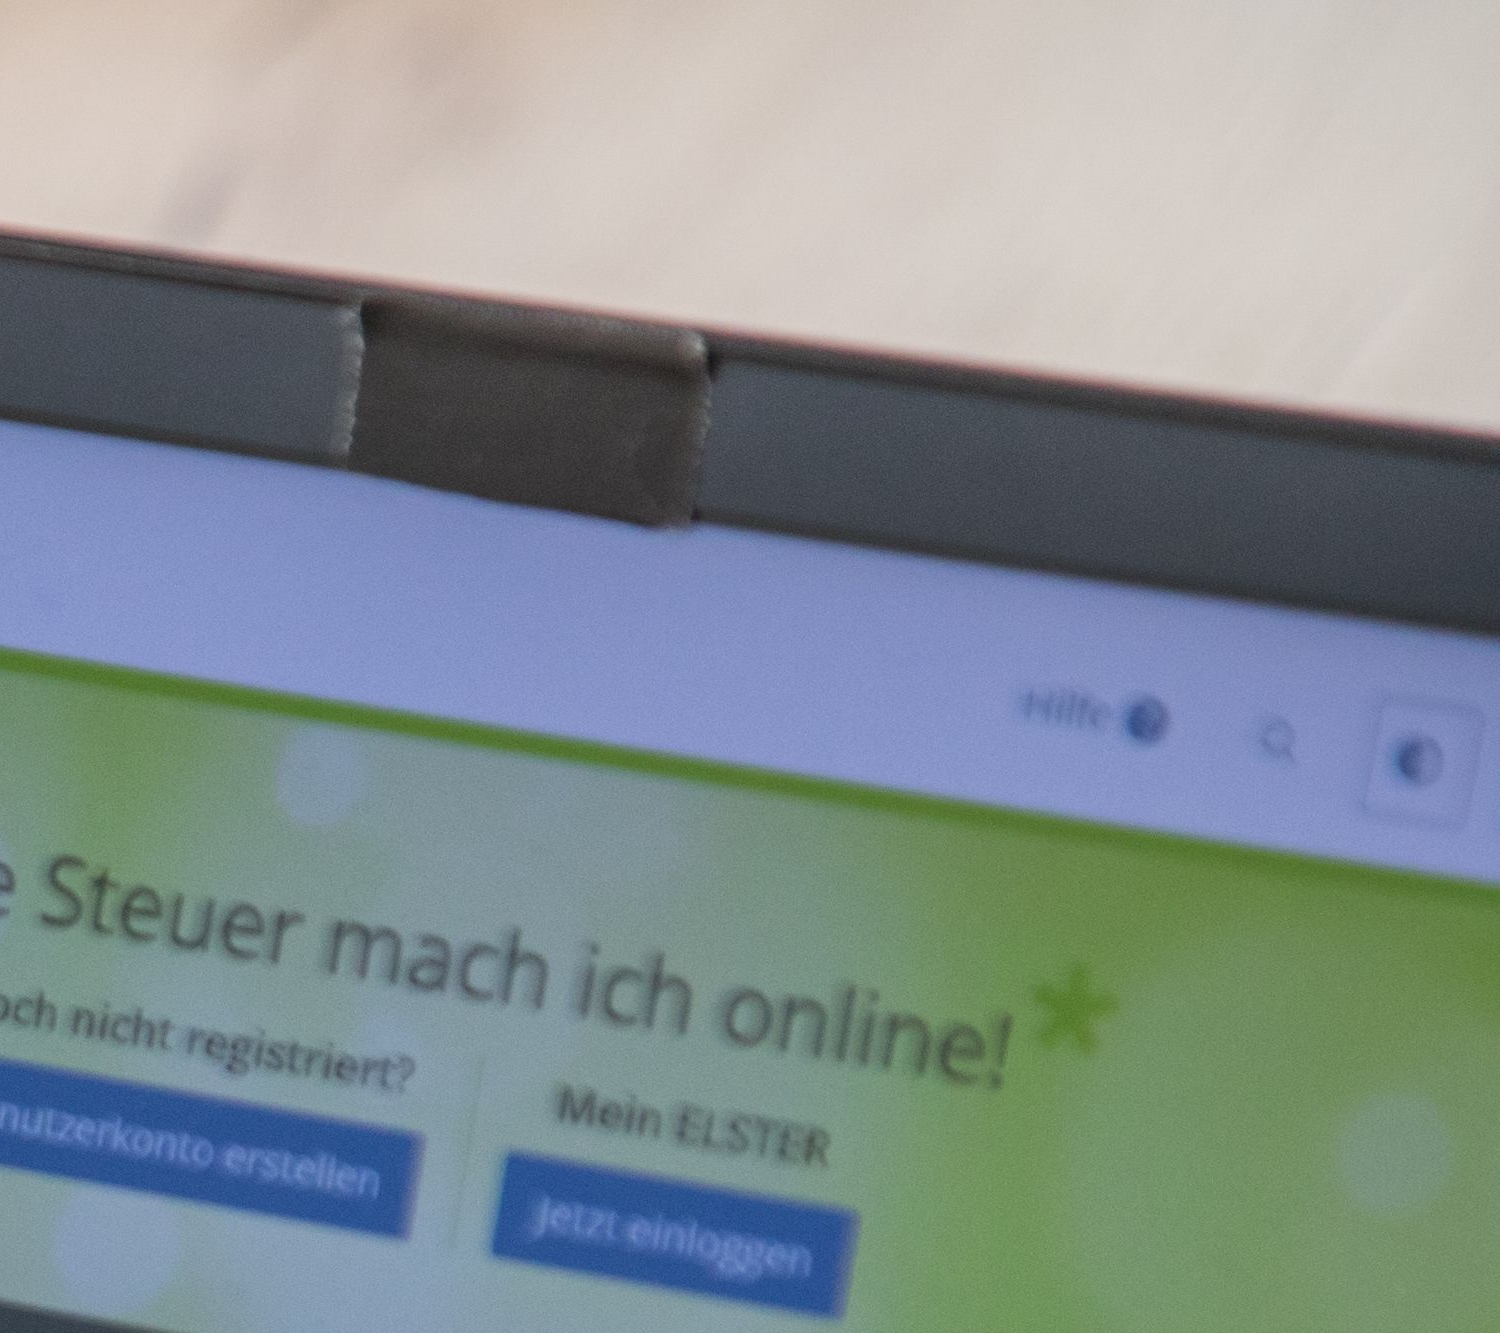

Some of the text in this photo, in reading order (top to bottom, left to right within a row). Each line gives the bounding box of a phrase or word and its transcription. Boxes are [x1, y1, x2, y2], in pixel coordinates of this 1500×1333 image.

[40, 853, 305, 965] Steuer
[327, 917, 548, 1010] mach
[574, 939, 694, 1038] ich
[722, 978, 1012, 1091] online!
[70, 1000, 172, 1051] nicht
[187, 1027, 416, 1093] registriert?
[224, 1132, 380, 1199] erstellen
[555, 1081, 830, 1169] Mein ELSTER
[529, 1197, 812, 1287] Jetzt einloggen
